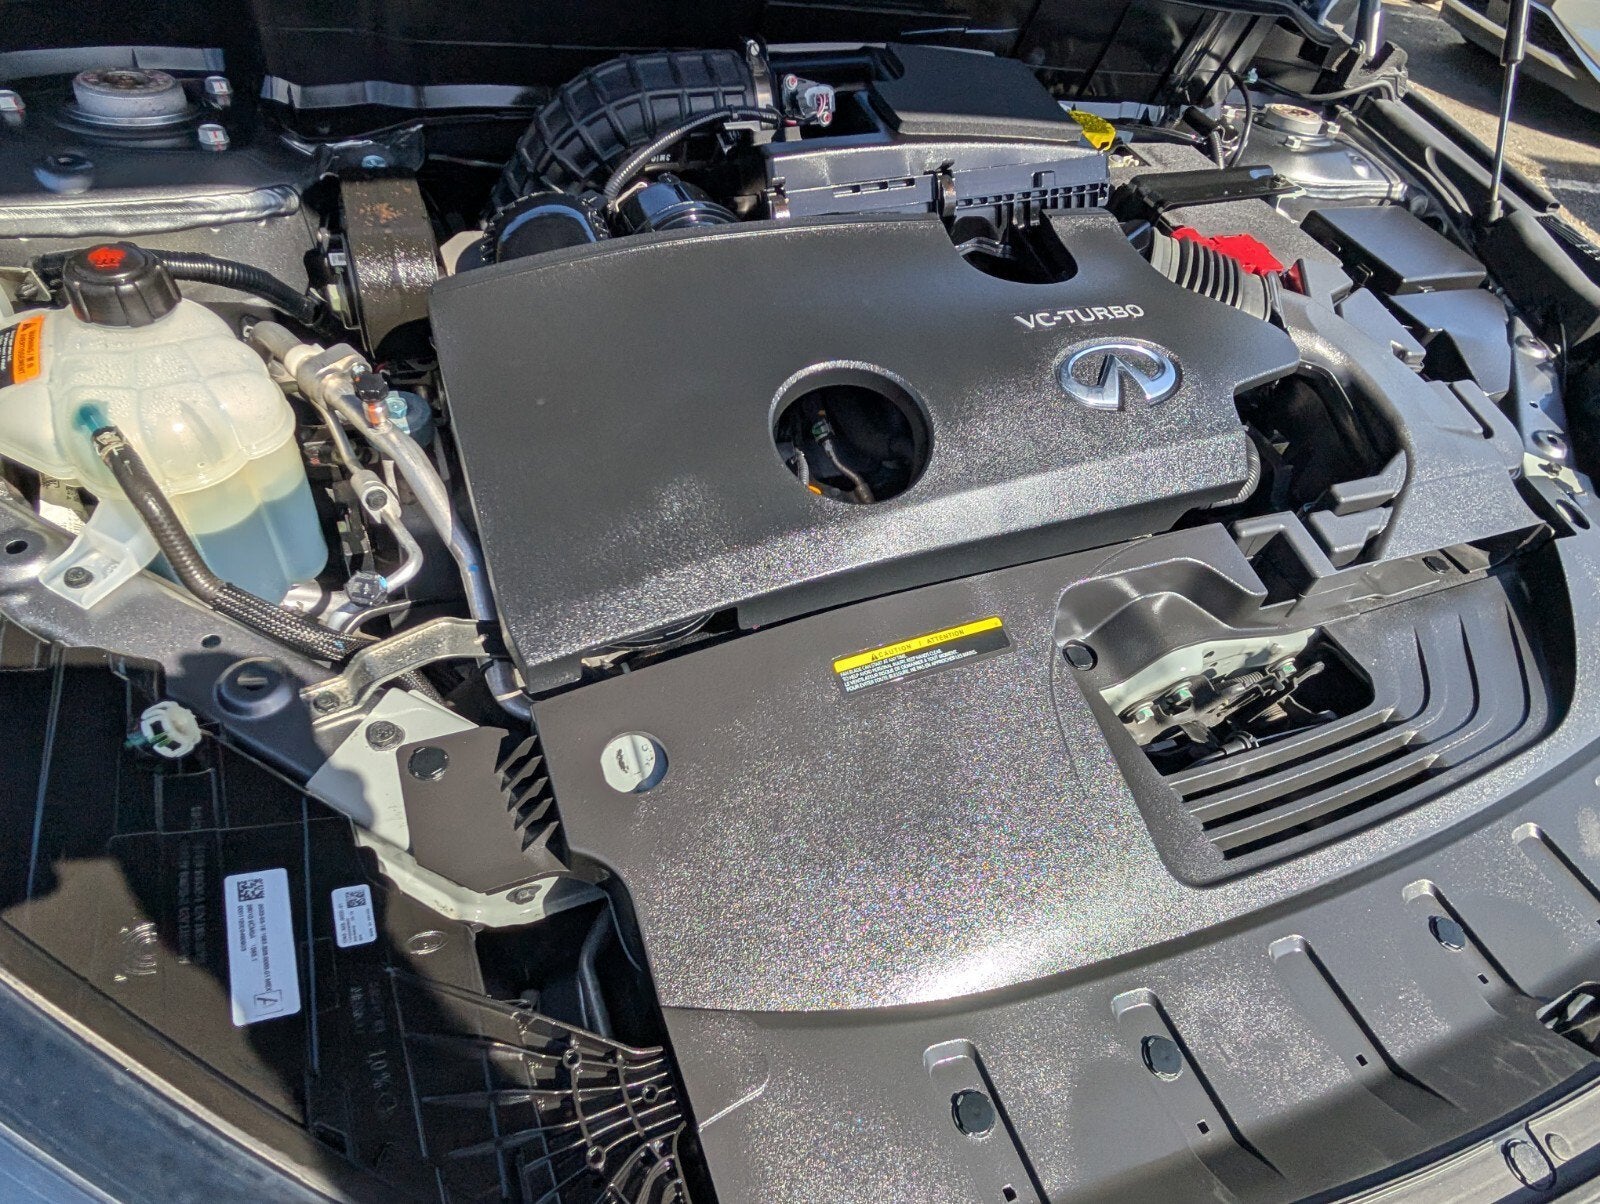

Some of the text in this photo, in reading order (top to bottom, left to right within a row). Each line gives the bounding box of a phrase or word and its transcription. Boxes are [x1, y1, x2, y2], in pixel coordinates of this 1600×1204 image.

[1013, 304, 1145, 329] VC-TURBO
[879, 643, 912, 658] CAUTION
[926, 629, 965, 644] ATTENTION
